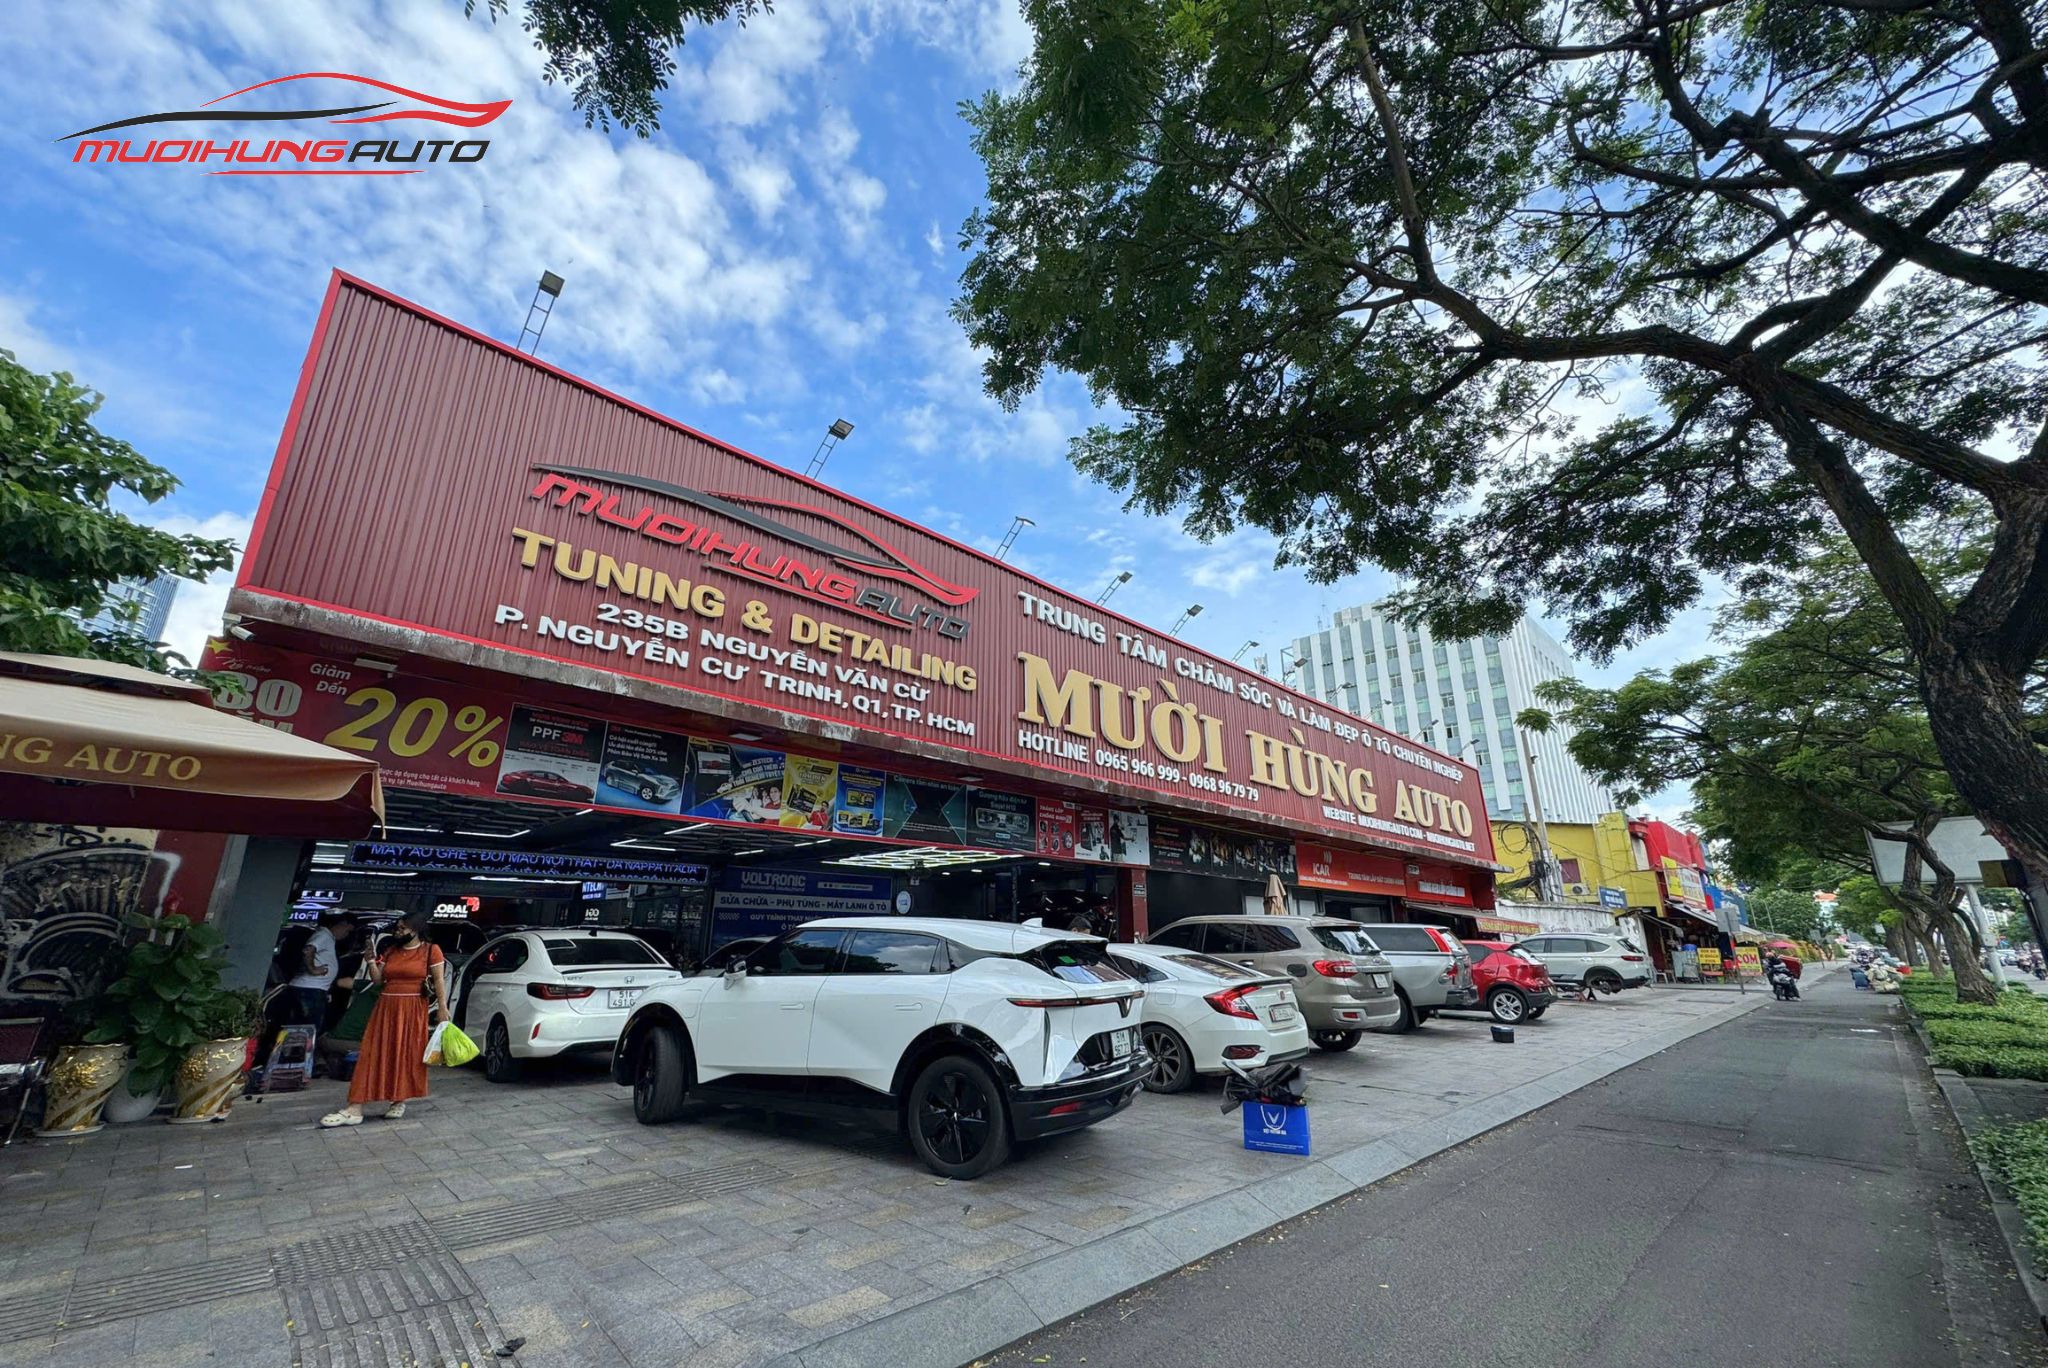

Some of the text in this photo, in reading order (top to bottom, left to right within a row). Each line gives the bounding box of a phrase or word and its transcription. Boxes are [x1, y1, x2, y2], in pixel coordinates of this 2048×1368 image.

[512, 527, 977, 691] TUNING & DETAILING
[495, 604, 528, 630] P.
[537, 616, 689, 668] NGUYỄN
[702, 656, 750, 680] CƯ
[596, 603, 930, 702] 235B NGUYỄN VĂN CỪ
[310, 663, 351, 680] Giảm
[316, 681, 347, 696] Đến
[1018, 591, 1463, 784] TRUNG TÂM CHĂM SÓC VÀ LÀM ĐẸP Ô TÔ CHUYÊN NGHIỆP
[323, 688, 504, 768] 20%
[532, 726, 562, 740] PPF
[1018, 652, 1473, 838] MƯỜI HÙNG AUTO
[64, 744, 202, 781] AUTO
[1095, 749, 1128, 772] 0965
[1131, 758, 1154, 778] 966
[1158, 765, 1180, 783] 999
[1189, 772, 1216, 792] 0968
[741, 871, 806, 887] VOLTRONIC
[720, 894, 740, 905] SỬA
[743, 895, 768, 906] CHỮA
[776, 899, 794, 909] PHỤ
[827, 901, 844, 910] MÁY
